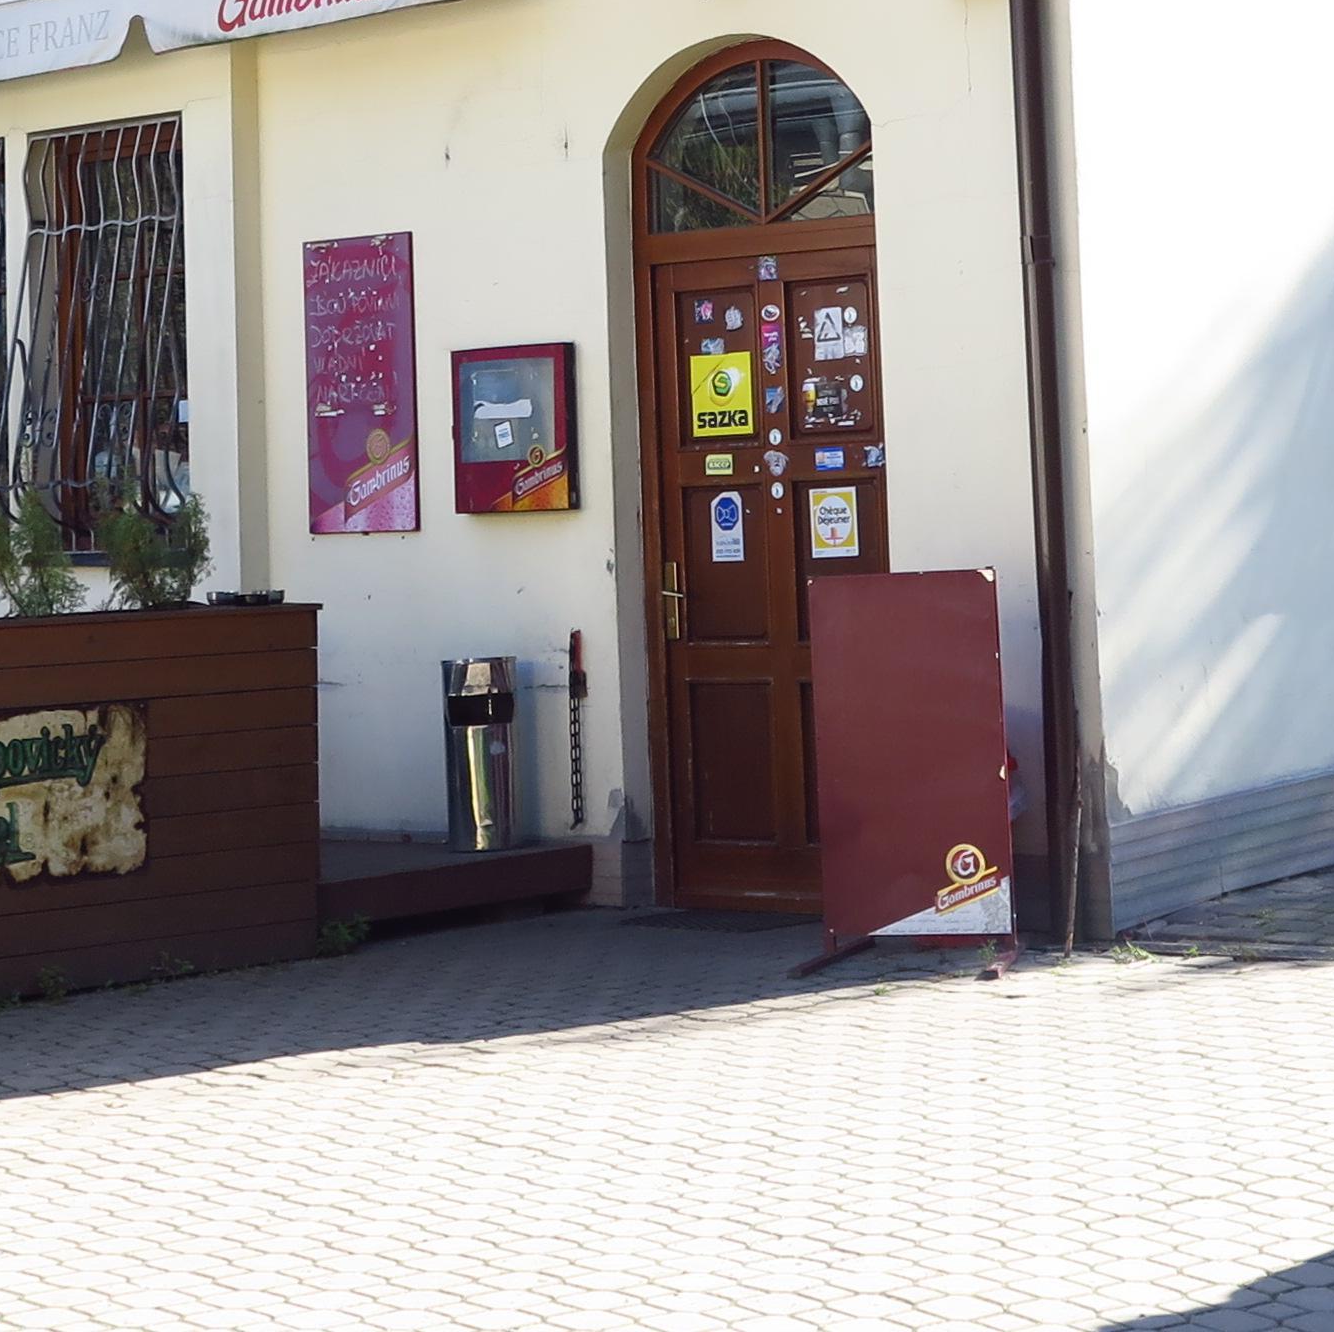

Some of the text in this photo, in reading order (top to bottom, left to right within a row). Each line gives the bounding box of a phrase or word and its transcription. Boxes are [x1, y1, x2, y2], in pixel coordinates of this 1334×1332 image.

[28, 9, 110, 55] FRANZ
[347, 455, 410, 506] Gambrinus
[514, 461, 564, 496] Gambrinus
[938, 877, 997, 910] Gambrinus
